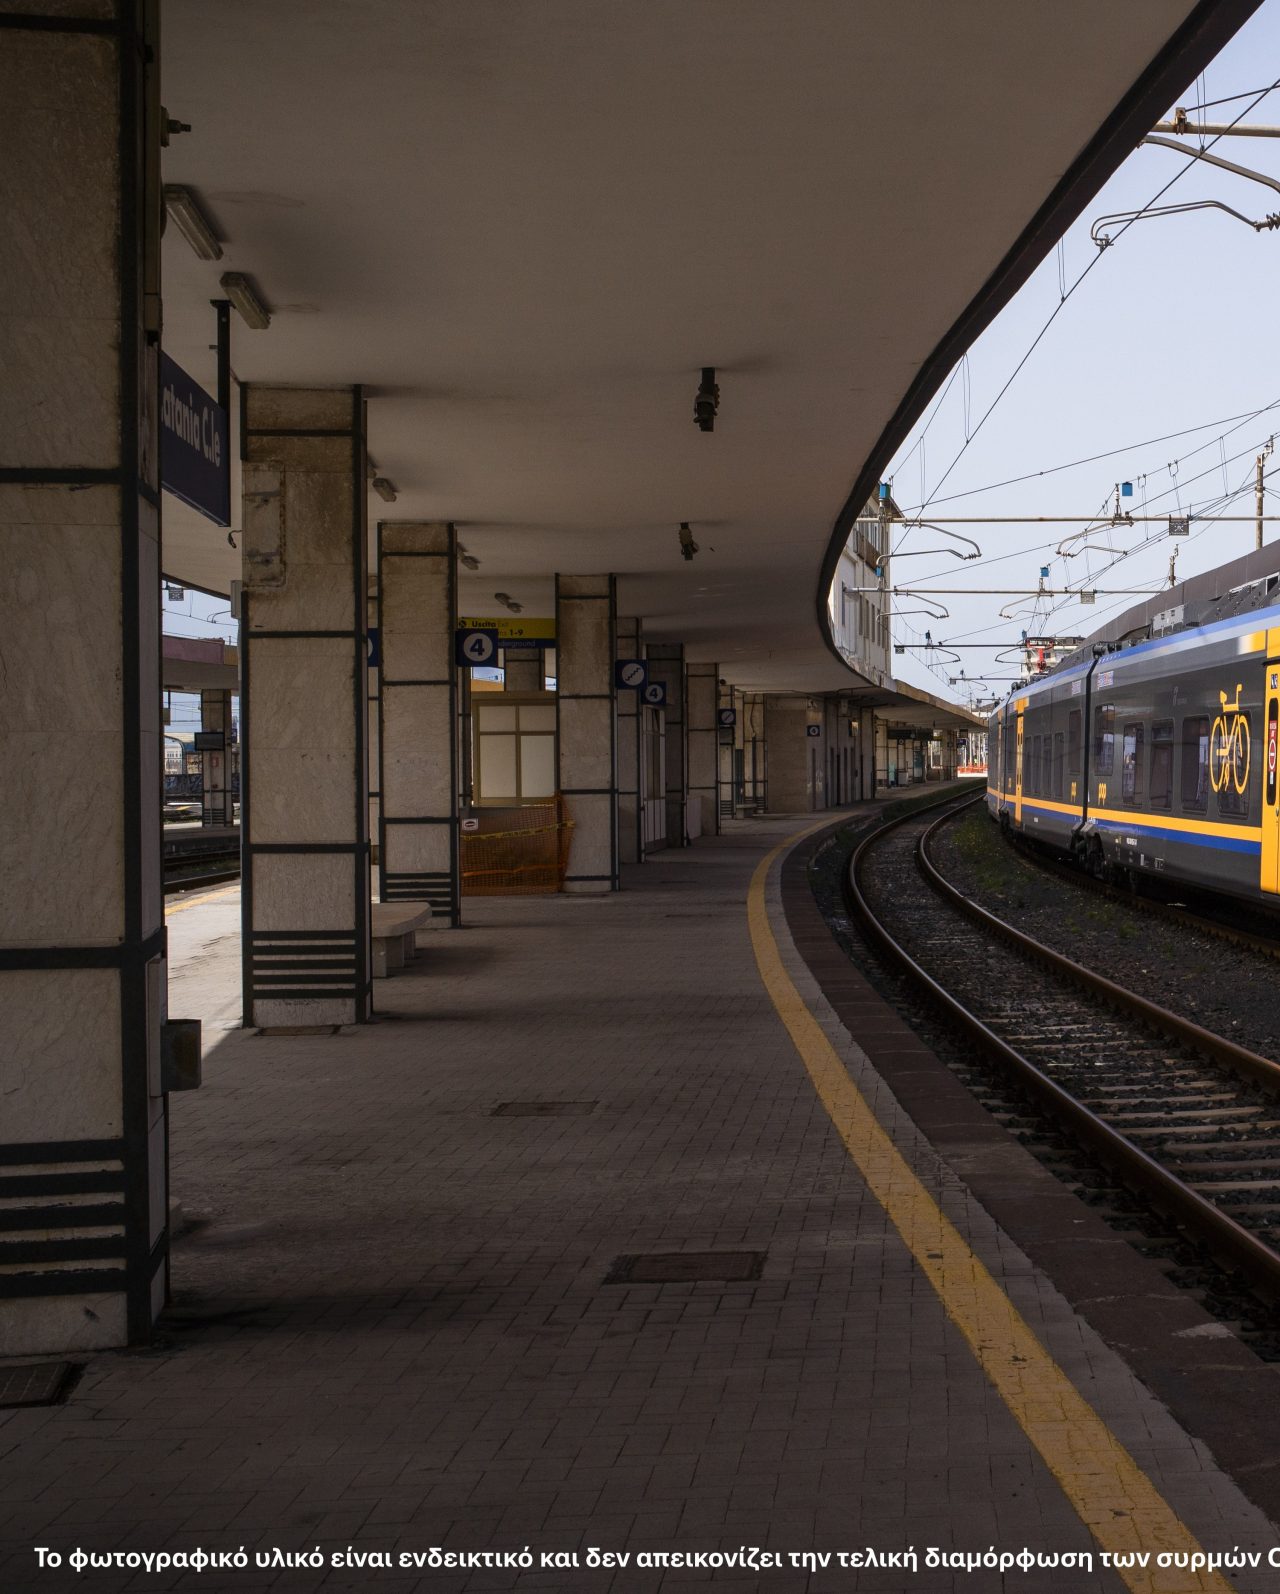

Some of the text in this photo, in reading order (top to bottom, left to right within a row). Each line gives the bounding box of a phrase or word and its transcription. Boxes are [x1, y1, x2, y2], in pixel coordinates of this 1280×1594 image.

[161, 383, 200, 453] atania
[469, 638, 485, 656] 4
[649, 687, 658, 699] 4
